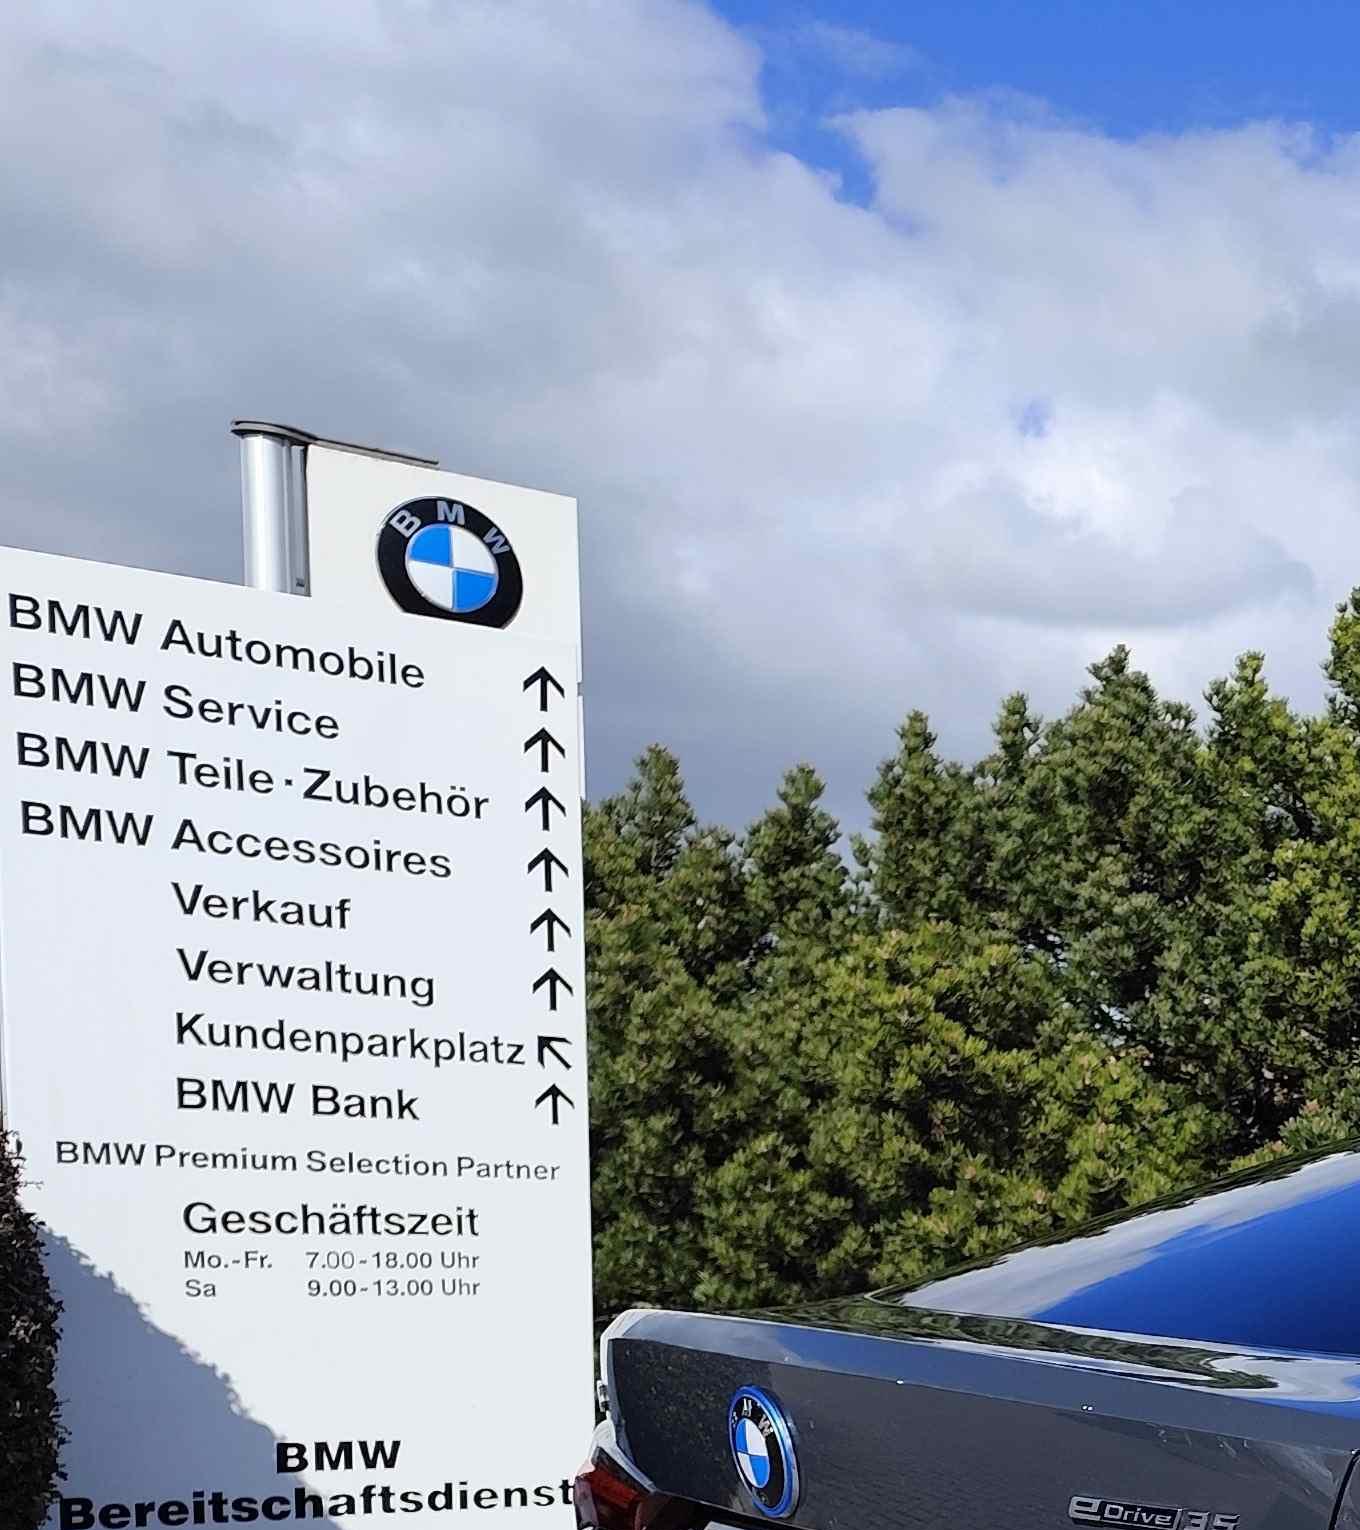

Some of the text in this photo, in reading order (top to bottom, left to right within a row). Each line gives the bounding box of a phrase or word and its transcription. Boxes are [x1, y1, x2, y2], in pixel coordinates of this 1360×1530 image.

[389, 500, 510, 554] BMW
[8, 592, 425, 689] BMW Automobile
[12, 661, 340, 740] BMW Service
[16, 731, 150, 780] BMW
[20, 800, 452, 878] BMW Accessoires
[170, 881, 351, 930] Verkauf
[175, 948, 434, 1008] Verwaltung
[175, 1012, 526, 1068] Kundenparkplatz
[176, 1077, 420, 1121] BMW Bank
[55, 1140, 560, 1181] BMW Premium Selection Partner
[183, 1201, 479, 1237] Geschäftszeit
[440, 1251, 480, 1269] Uhr
[185, 1279, 217, 1297] Sa
[441, 1278, 480, 1296] Uhr
[276, 1440, 401, 1474] BMW
[1069, 1496, 1173, 1526] eDrive
